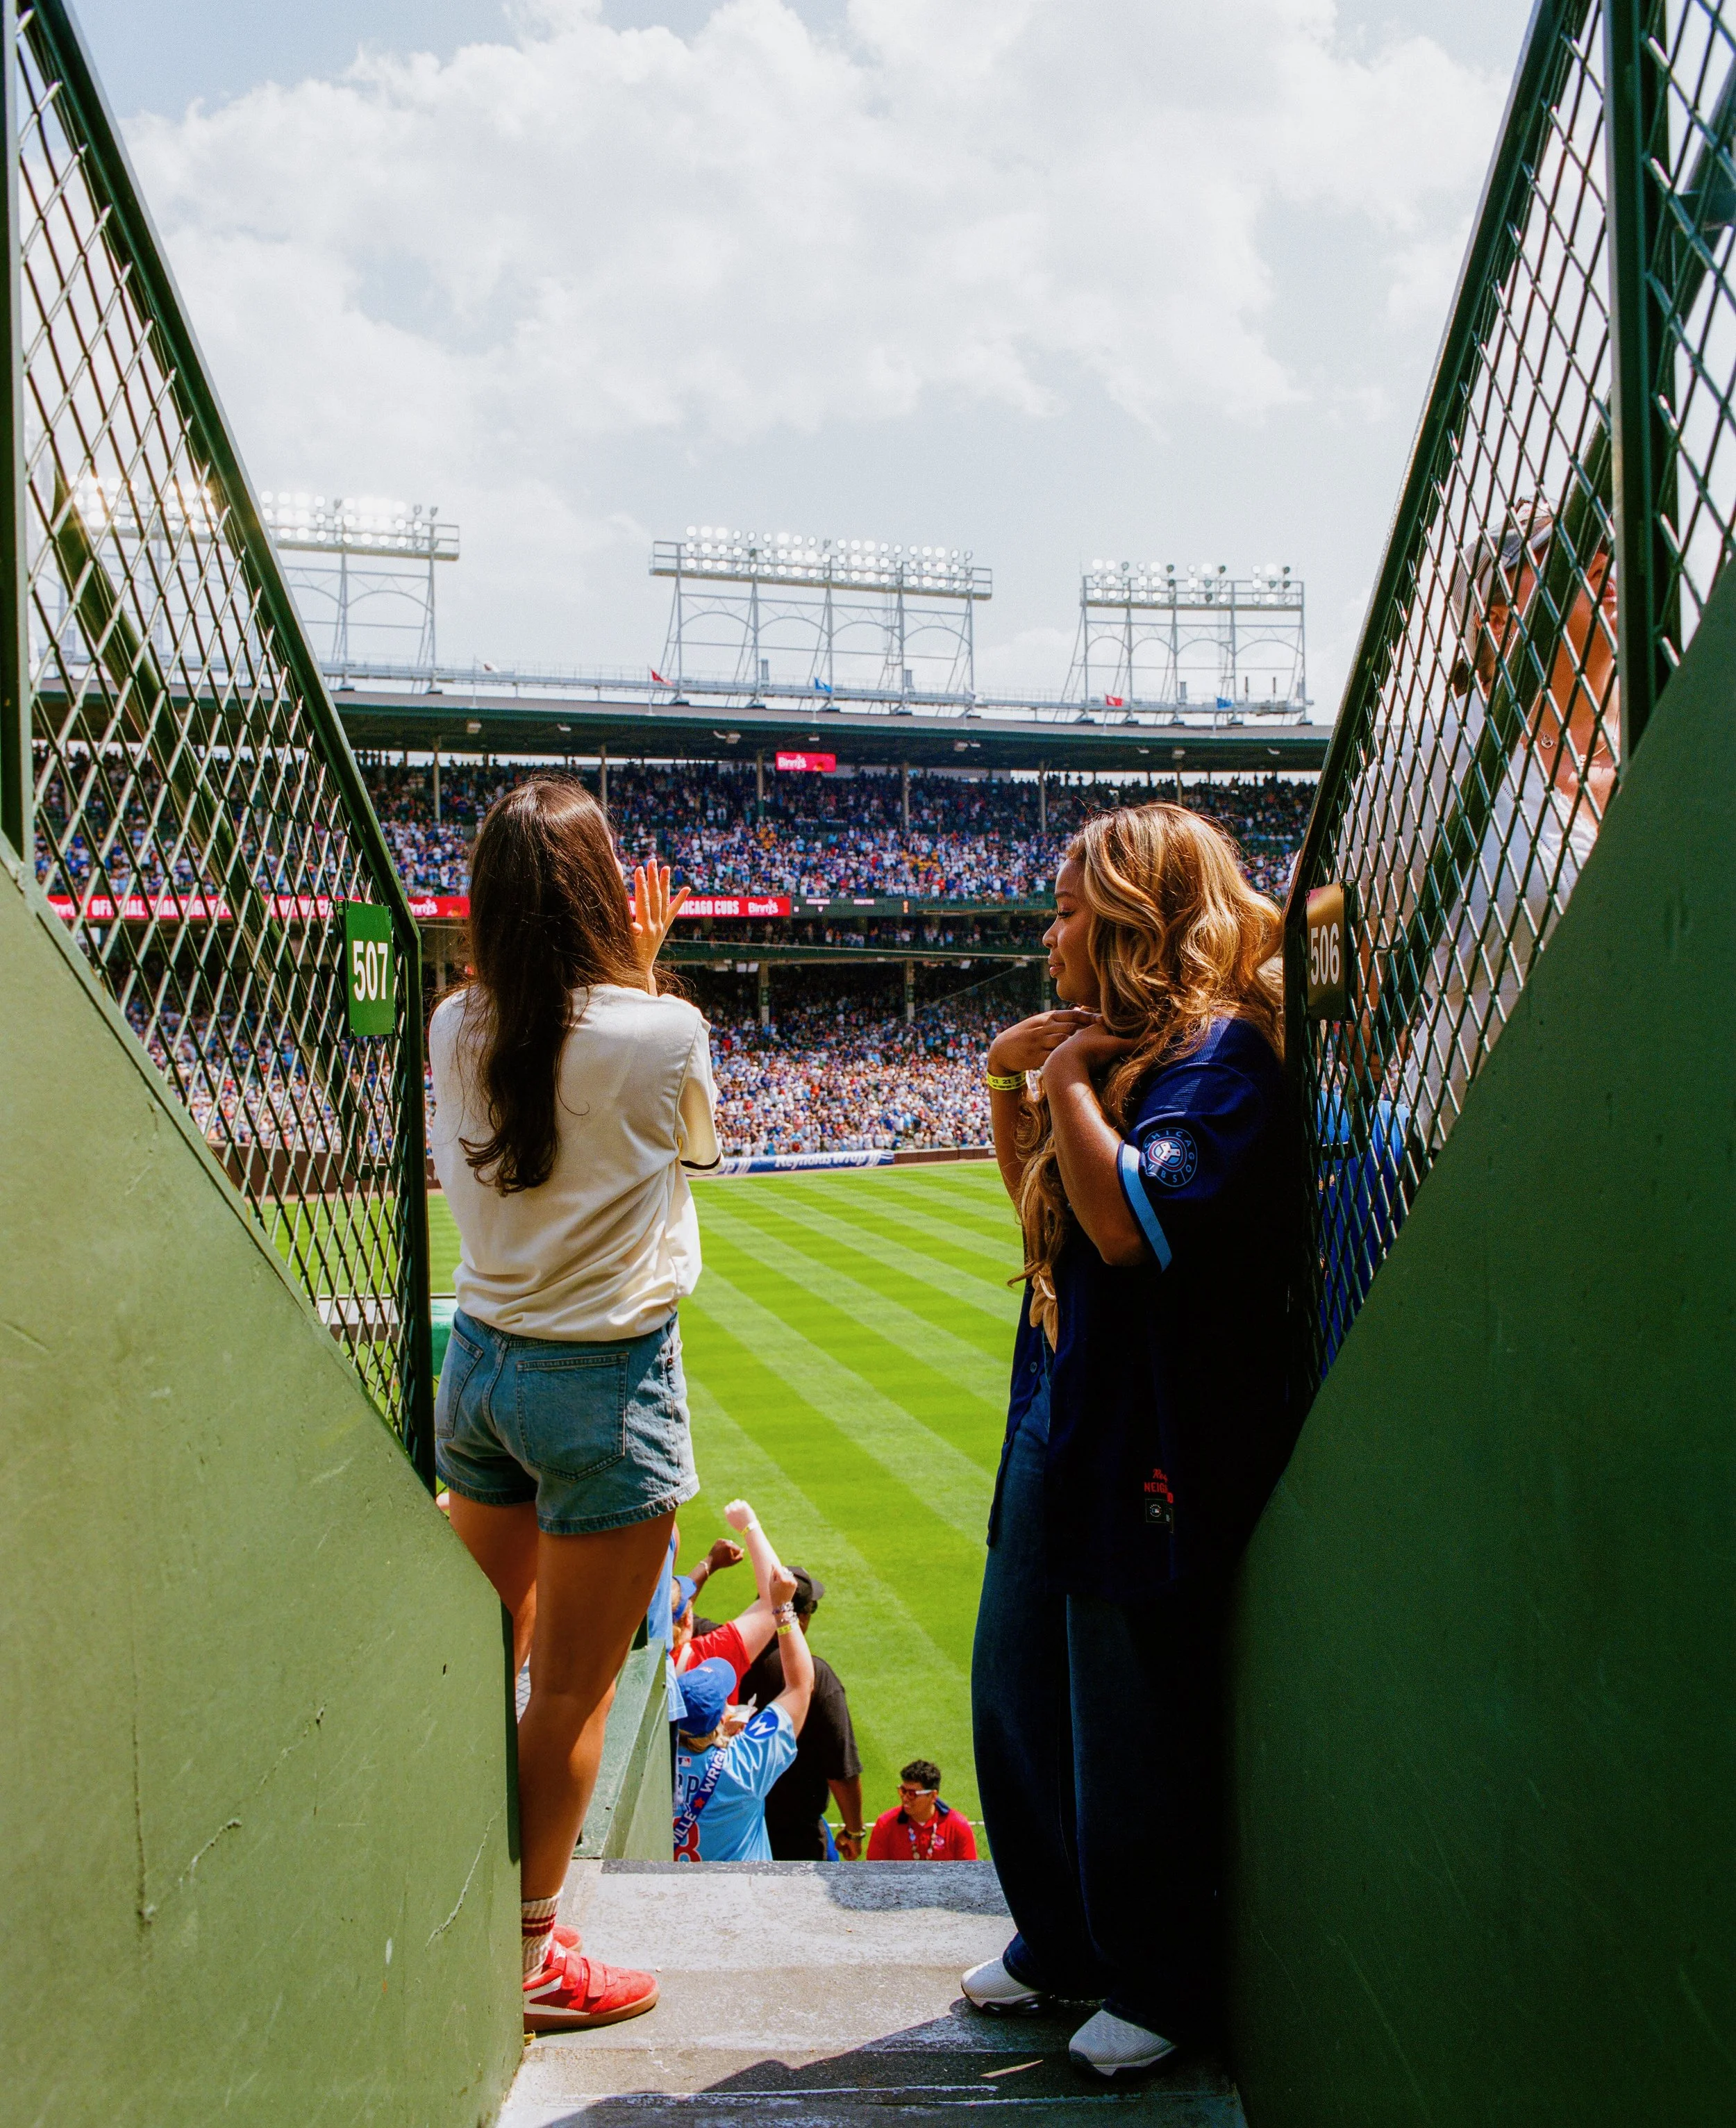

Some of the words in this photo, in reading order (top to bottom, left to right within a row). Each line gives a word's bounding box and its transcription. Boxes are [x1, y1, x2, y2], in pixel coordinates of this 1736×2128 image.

[92, 899, 145, 916] OFFIAL
[409, 897, 438, 915] nny's
[677, 900, 713, 915] ICAGO
[715, 900, 740, 915] CUBS
[748, 899, 778, 915] Binny's
[1310, 922, 1339, 986] 506
[353, 940, 388, 1001] 507
[1144, 1130, 1195, 1173] CHICAGO
[749, 1715, 776, 1736] W
